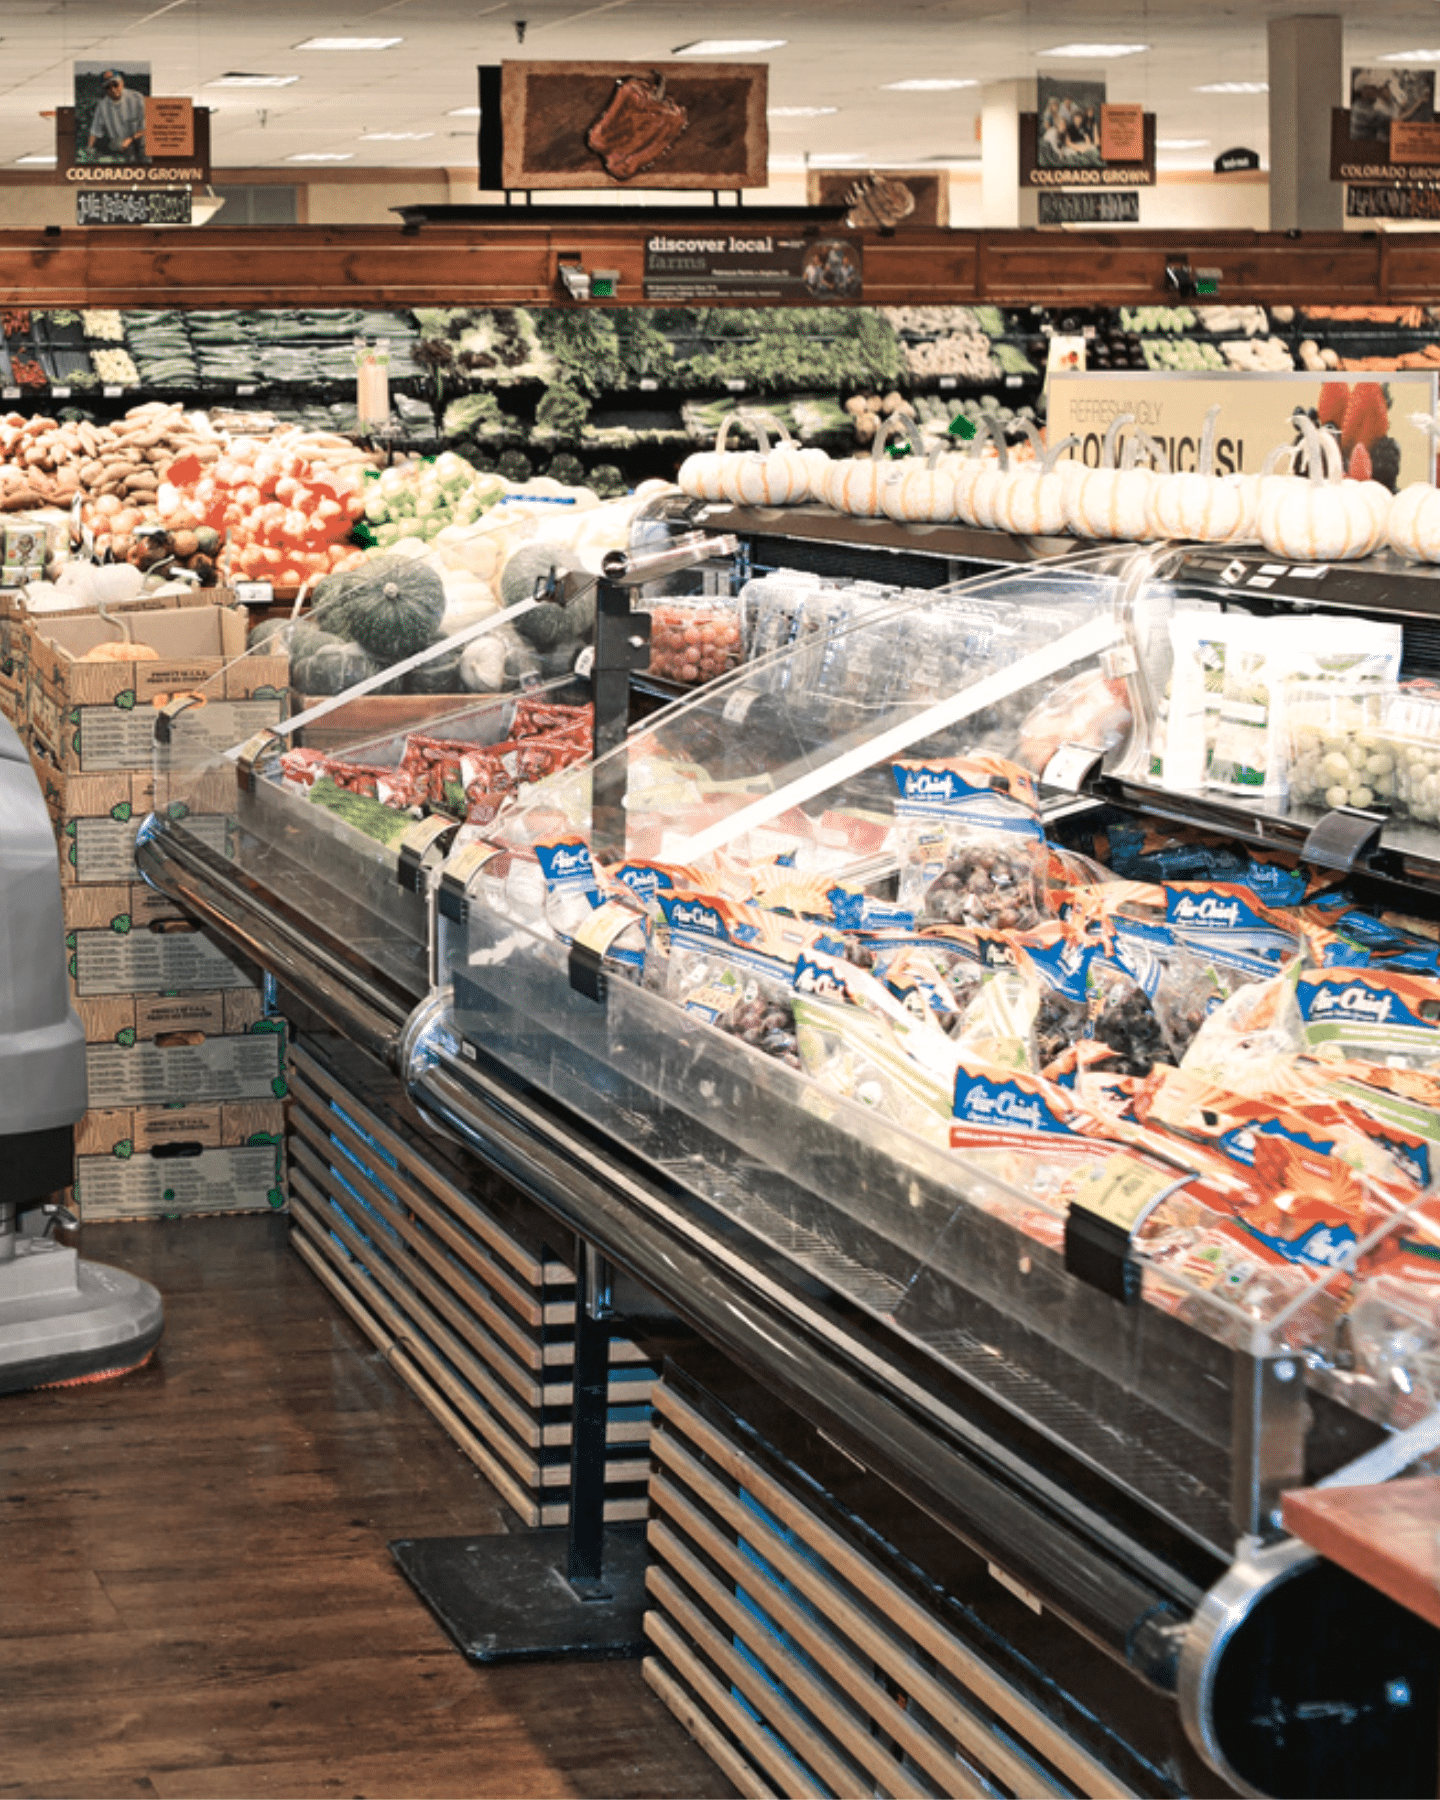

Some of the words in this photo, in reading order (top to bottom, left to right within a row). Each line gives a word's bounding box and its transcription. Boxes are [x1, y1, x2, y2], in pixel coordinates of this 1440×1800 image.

[66, 167, 146, 181] COLORADO
[147, 167, 203, 181] GROWN
[1030, 169, 1100, 184] COLORADO
[1102, 169, 1150, 184] GROWN
[1340, 163, 1407, 179] COLORADO
[647, 235, 726, 253] discover
[728, 235, 774, 253] local
[647, 253, 707, 270] farms
